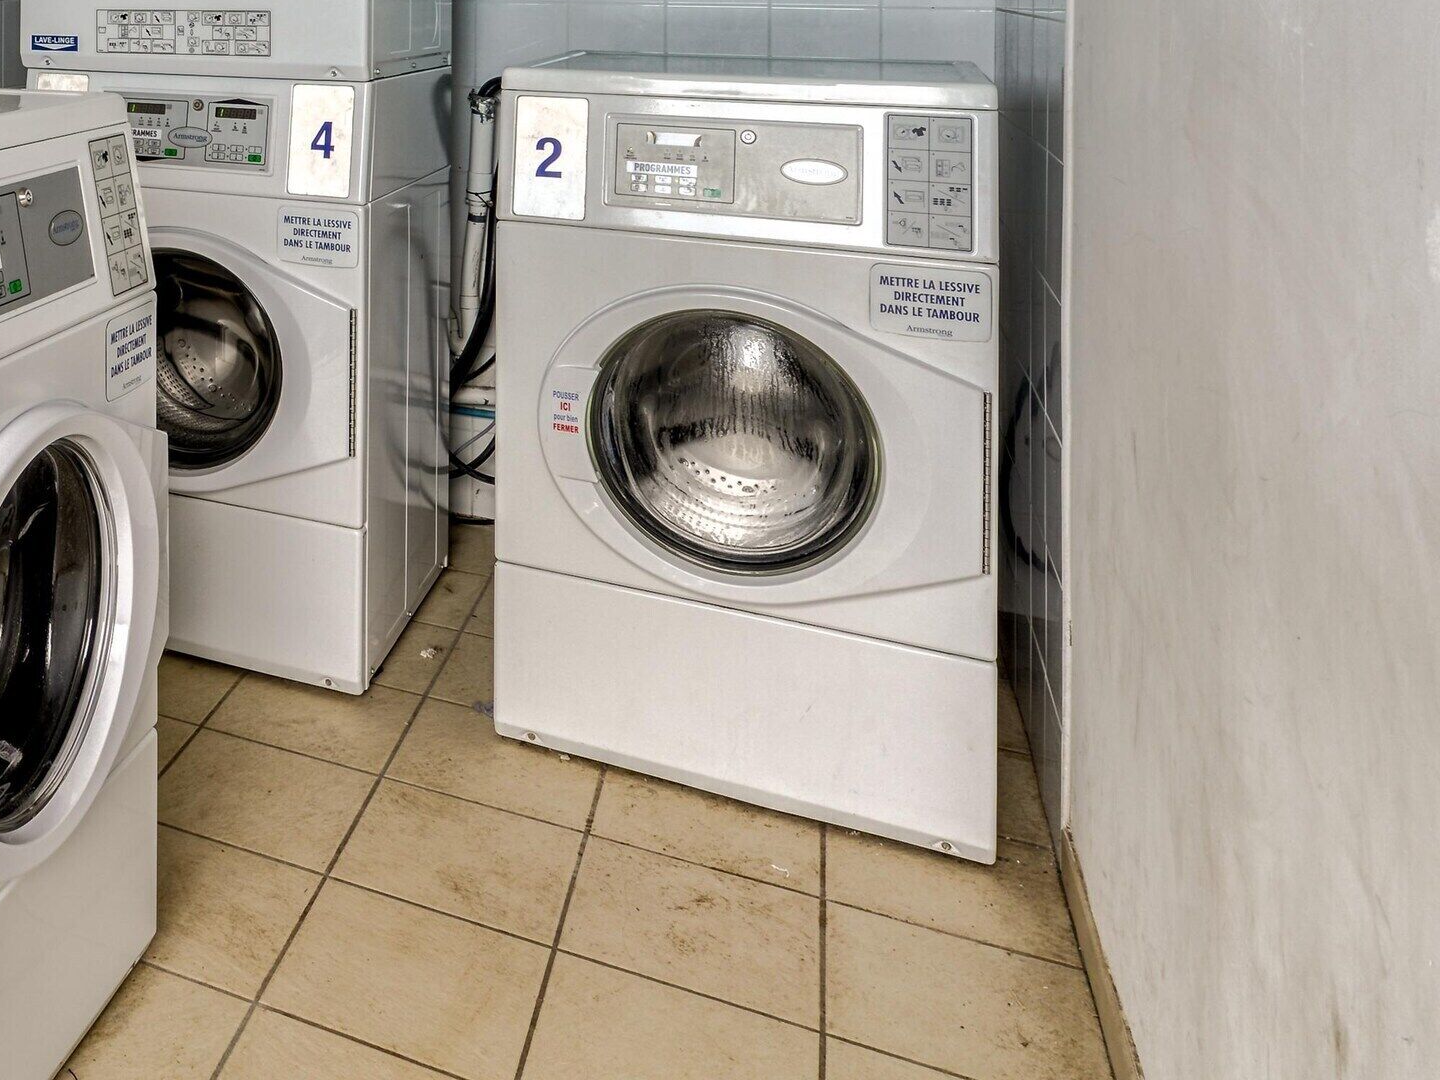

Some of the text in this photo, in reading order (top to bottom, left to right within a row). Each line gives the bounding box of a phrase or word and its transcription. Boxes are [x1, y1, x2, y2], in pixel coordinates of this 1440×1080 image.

[310, 121, 334, 159] 4
[534, 137, 563, 179] 2
[634, 163, 690, 175] PROGRAMMES
[284, 216, 351, 229] METTRE LA LESSIVE
[293, 228, 341, 240] DIRECTEMENT
[284, 239, 303, 247] DANS
[315, 242, 351, 252] TAMBOUR
[880, 276, 980, 294] METTRE LA LESSIVE
[894, 291, 965, 306] DIRECTEMENT
[880, 304, 979, 322] DANS LE TAMBOUR
[111, 315, 152, 344] METTRE LA LESSIVE
[906, 325, 953, 336] Armstrong
[117, 334, 146, 358] DIRECTEMENT
[111, 347, 151, 378] DANS LE TAMBOUR
[553, 391, 579, 401] POUSSER
[560, 402, 570, 411] ICI
[553, 423, 579, 433] FERMER
